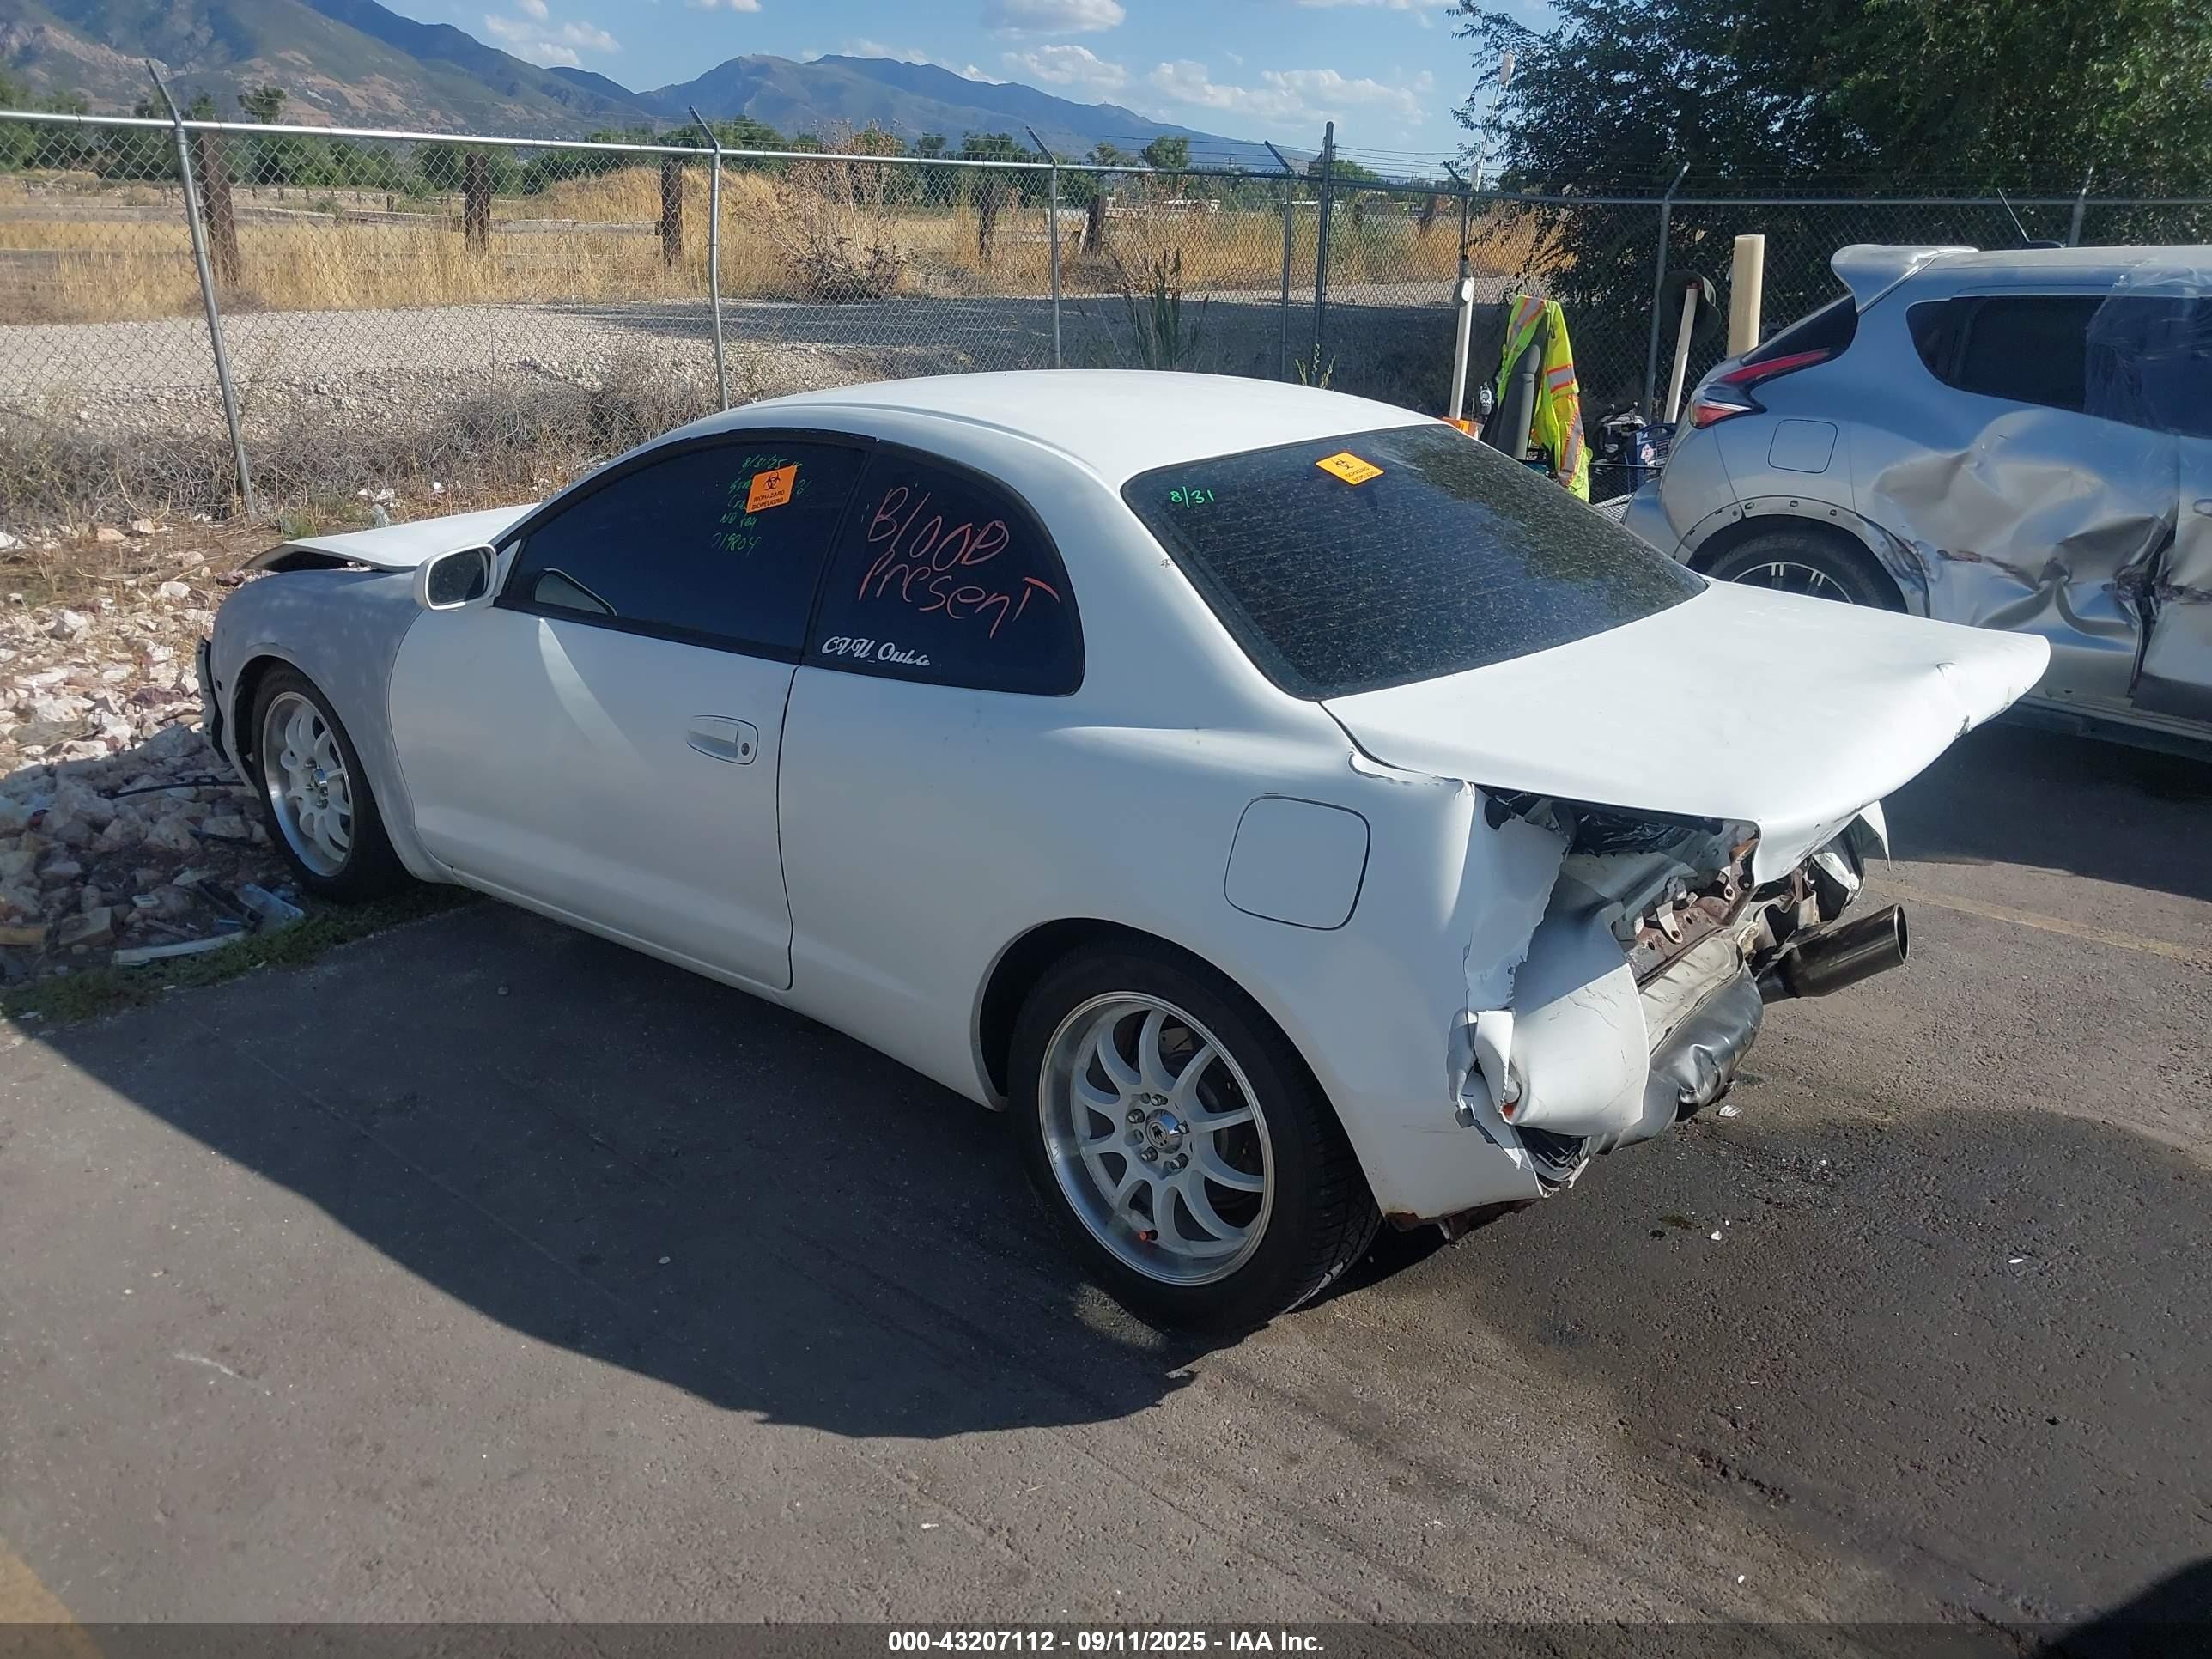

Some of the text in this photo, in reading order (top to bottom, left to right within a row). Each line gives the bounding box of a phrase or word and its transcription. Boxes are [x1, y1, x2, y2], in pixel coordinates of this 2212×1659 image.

[753, 489, 785, 503] BIOHAZARD
[1170, 486, 1214, 508] 8/31
[751, 497, 784, 511] BIOPELIGRO
